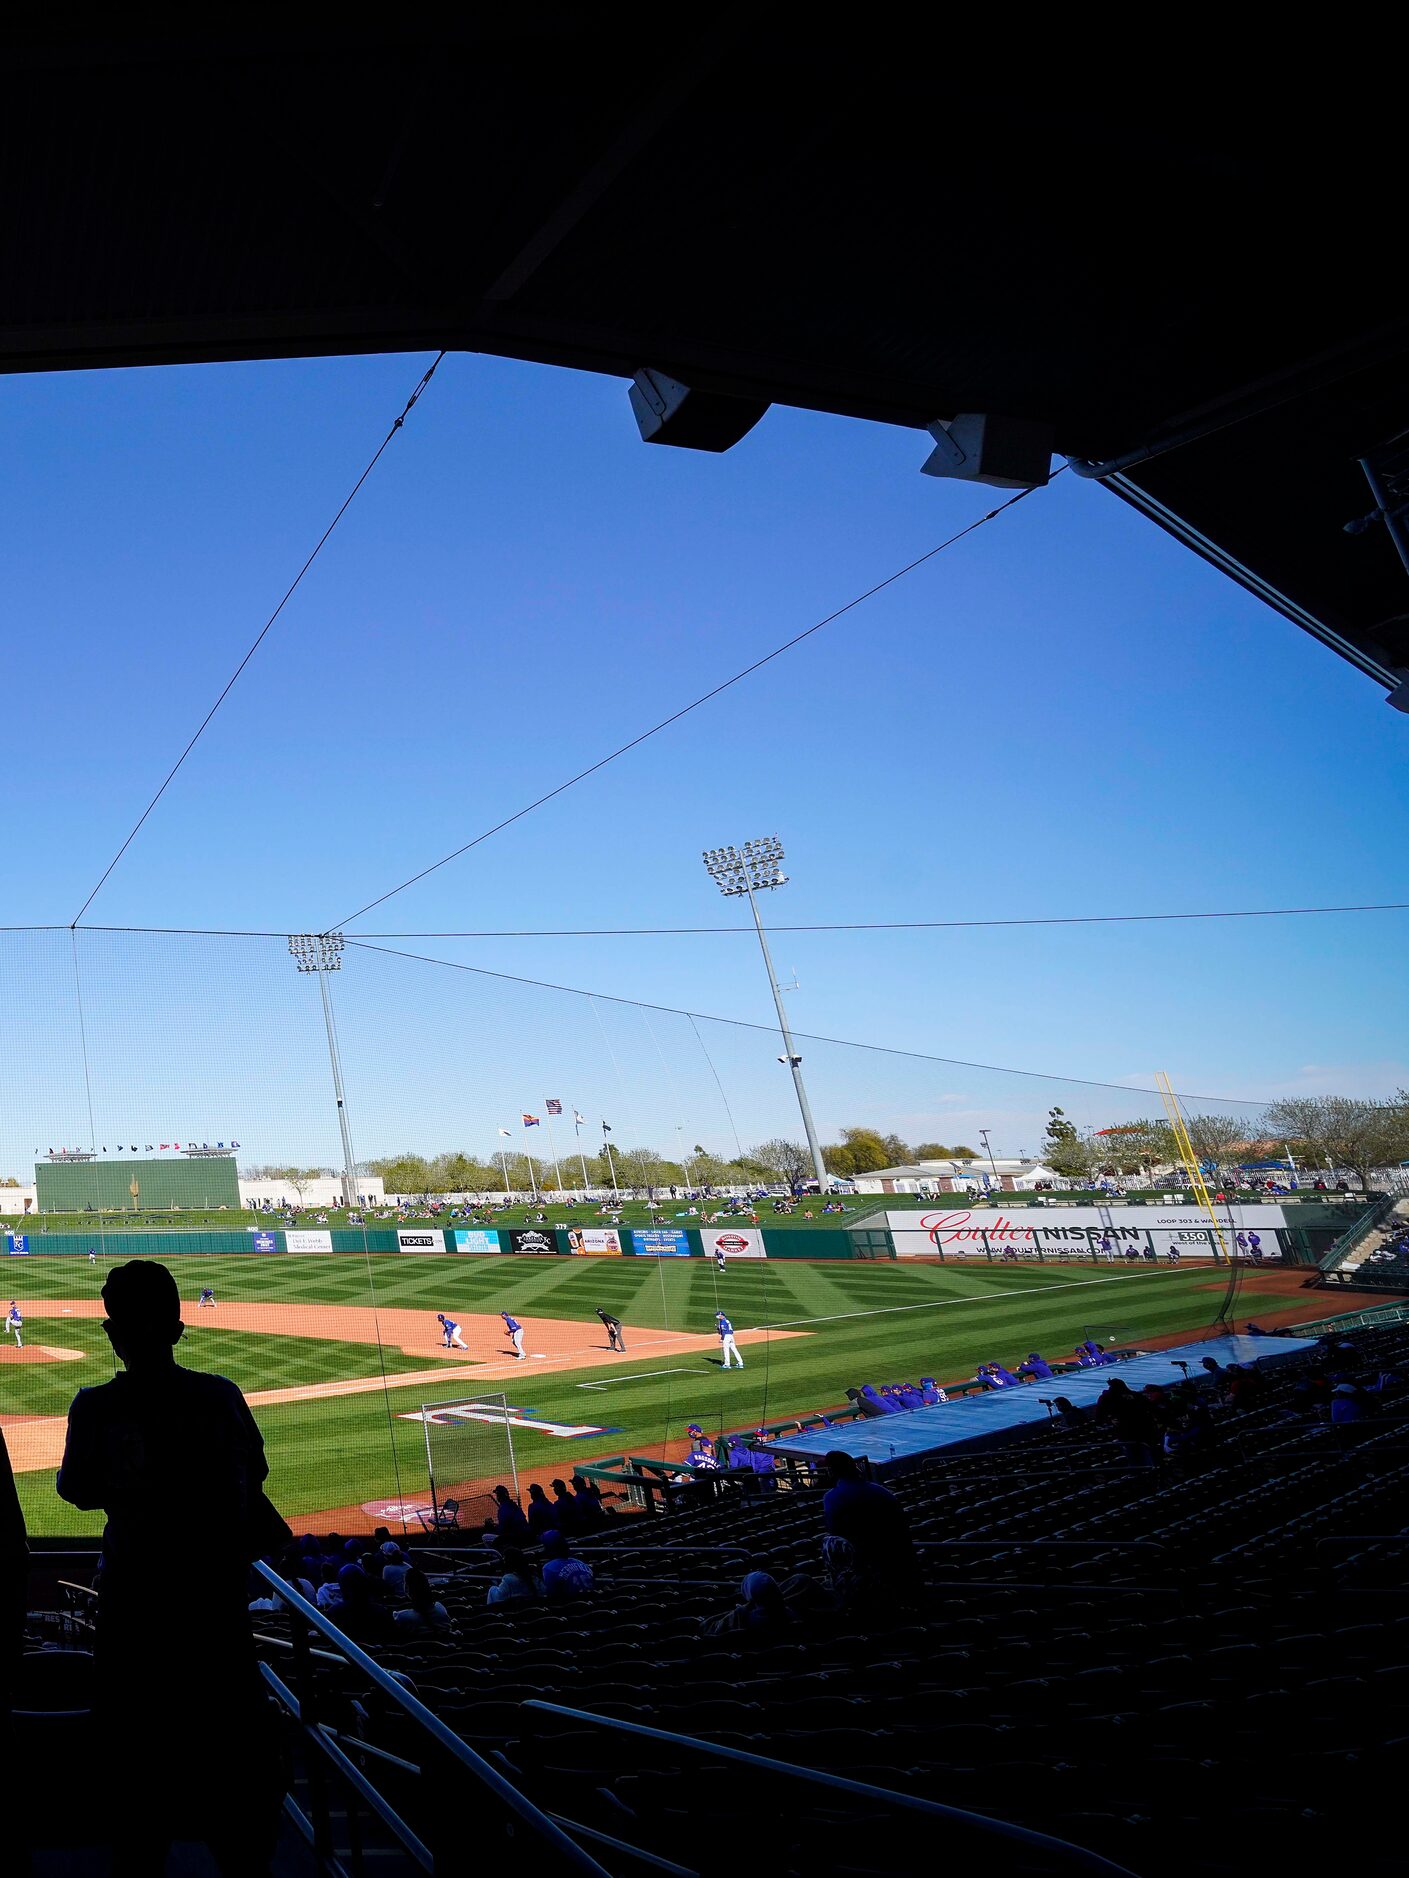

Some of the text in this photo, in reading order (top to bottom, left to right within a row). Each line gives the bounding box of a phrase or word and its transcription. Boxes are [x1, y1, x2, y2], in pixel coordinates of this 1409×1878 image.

[920, 1212, 1035, 1244] Coulter
[1042, 1226, 1140, 1240] NISSAN
[1182, 1232, 1205, 1241] 350
